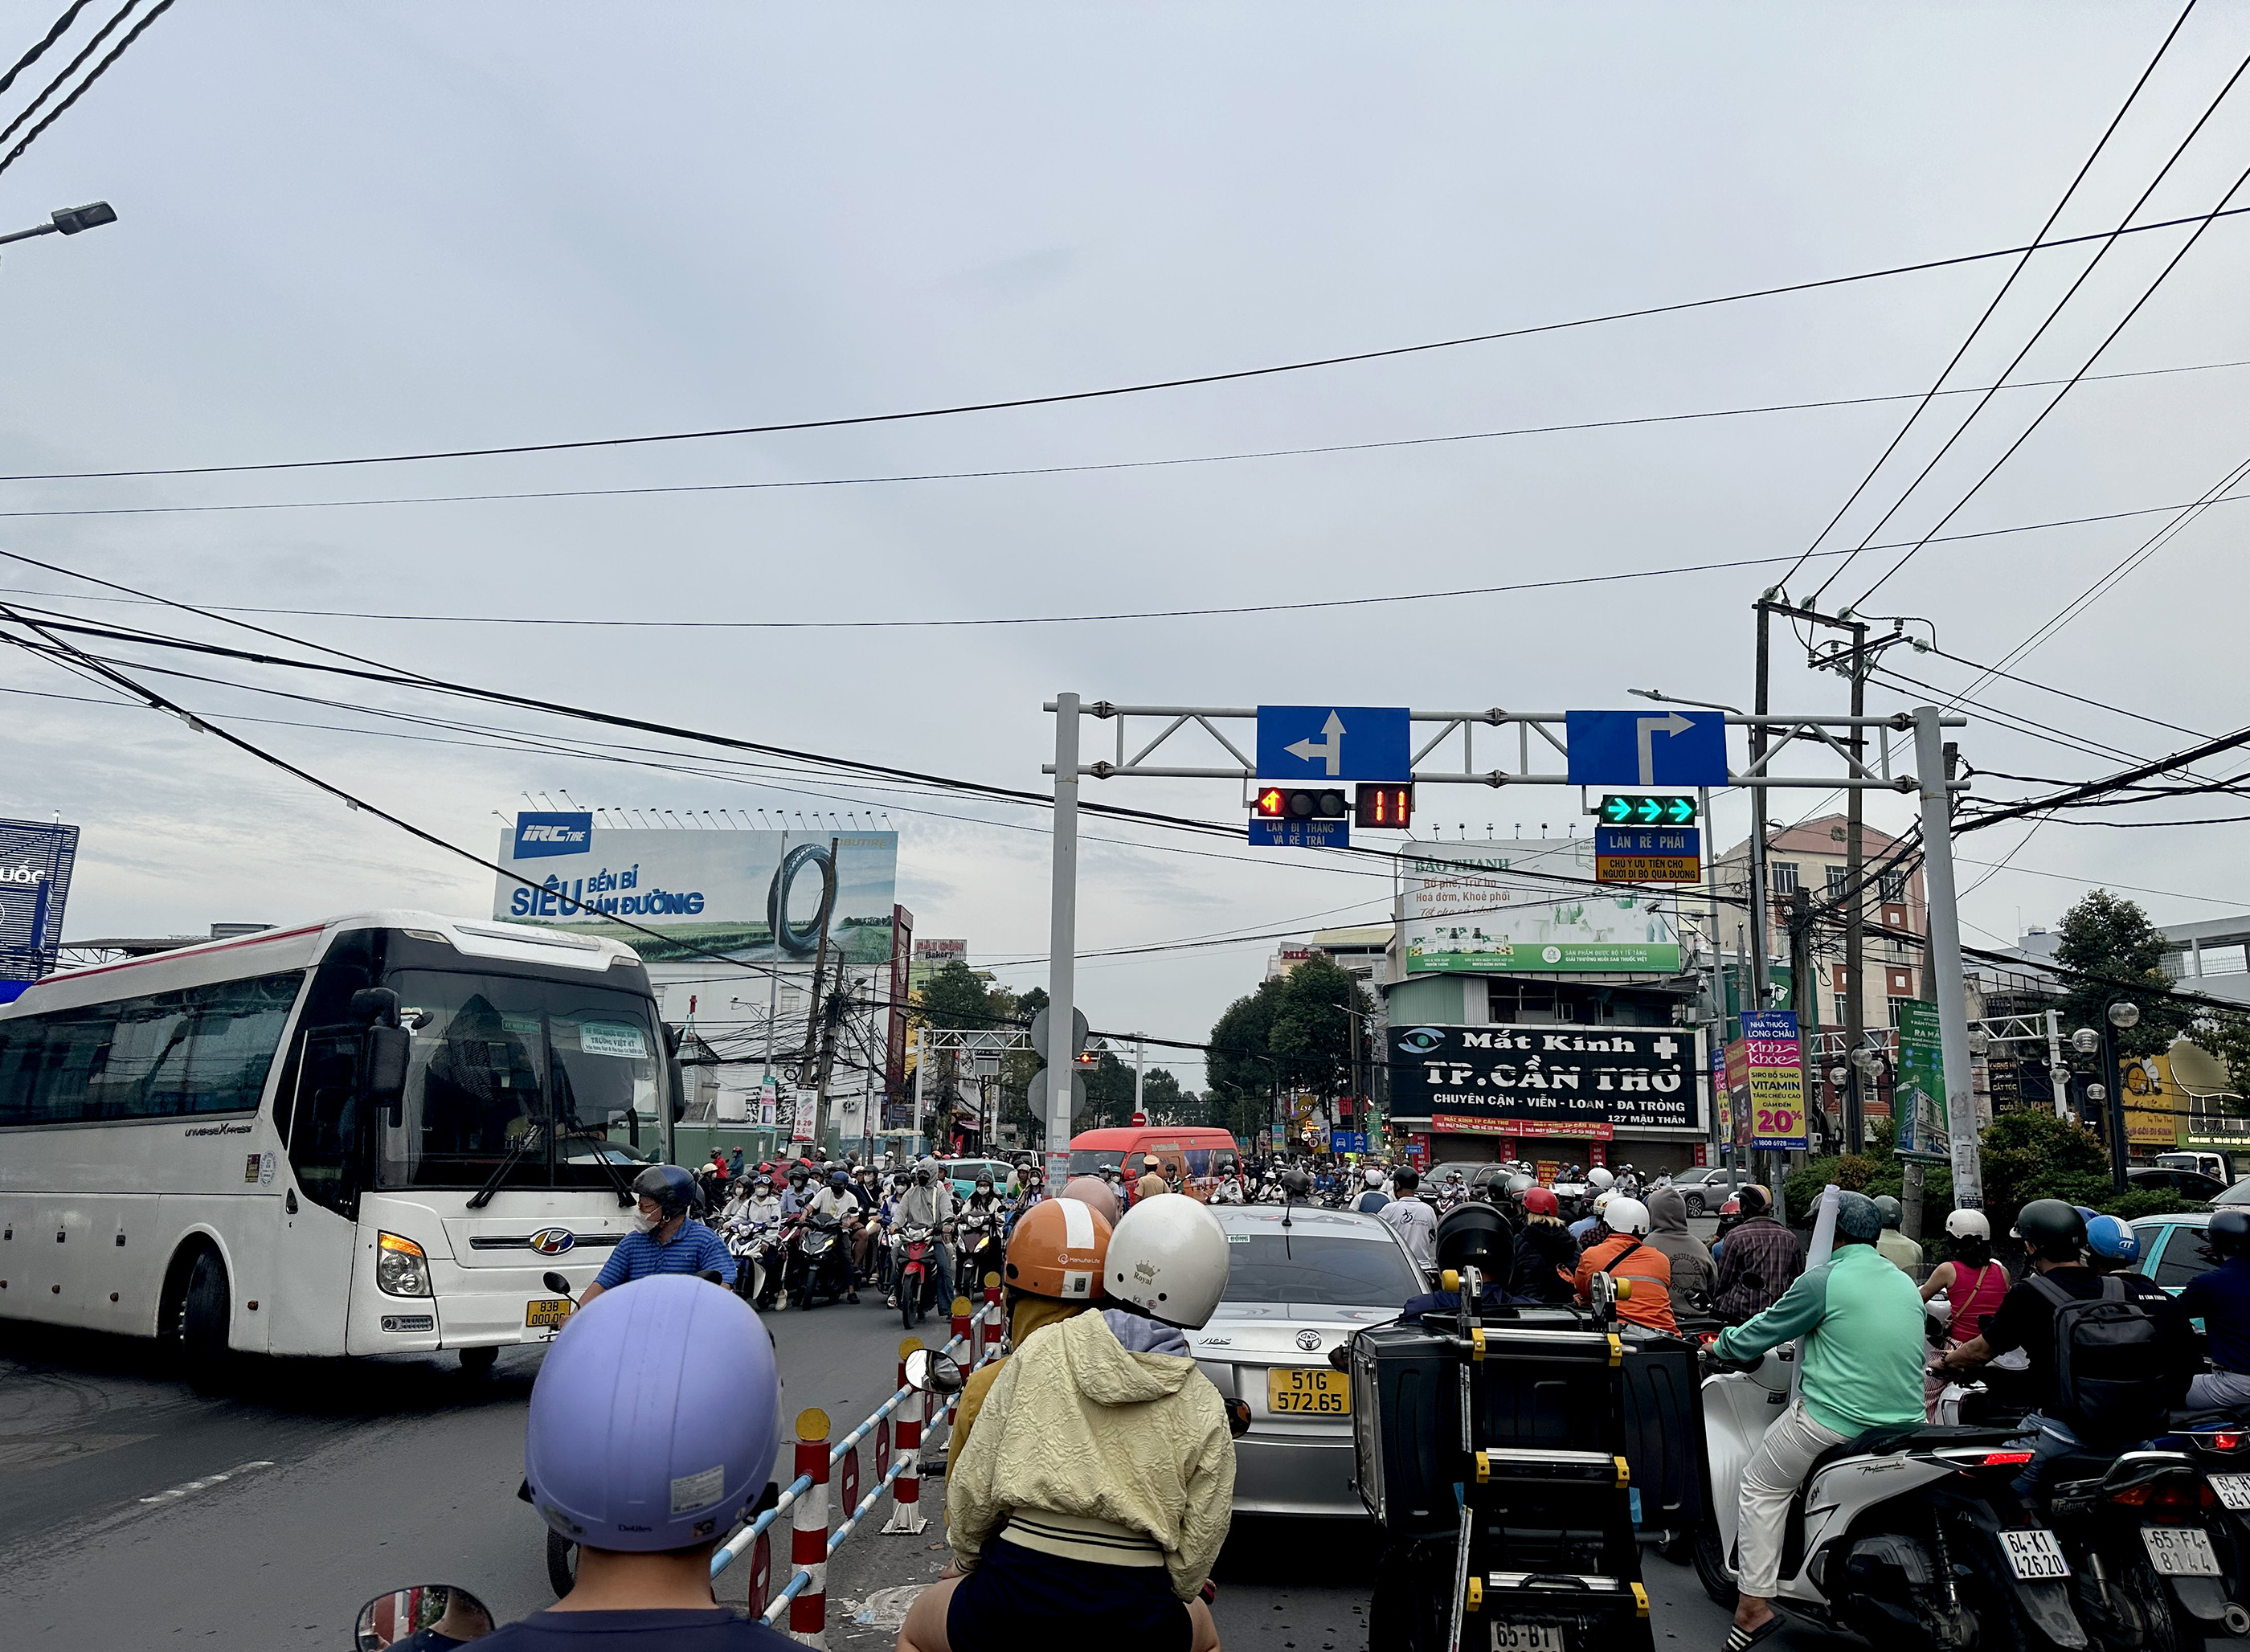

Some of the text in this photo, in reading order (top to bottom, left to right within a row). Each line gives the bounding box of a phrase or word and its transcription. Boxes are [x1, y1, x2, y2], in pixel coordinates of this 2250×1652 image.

[1377, 791, 1405, 821] 11
[1291, 823, 1299, 832] ĐI
[565, 831, 586, 842] TIRE
[828, 837, 888, 848] OBUTIRE
[1273, 833, 1325, 845] VÀ RẼ TRÁI
[1610, 832, 1684, 848] LÀN RẼ PHẢI
[1667, 860, 1683, 868] CHO
[1628, 869, 1636, 878] ĐI
[1651, 869, 1667, 879] QUA
[510, 874, 583, 916] SIÊU
[584, 889, 705, 916] BÁM ĐƯỜNG
[1765, 1020, 1790, 1028] THUỐC
[1748, 1028, 1795, 1038] LONG CHÂU
[1914, 1029, 1925, 1037] RA
[1462, 1029, 1636, 1053] Mắt Kính
[1596, 1064, 1681, 1093] THƠ
[1751, 1081, 1800, 1090] VITAMIN
[1433, 1092, 1685, 1112] CHUYÊN CẬN VIỄN LOAN ĐA TRÒNG
[1607, 1114, 1686, 1125] 127 MẬU THÂN
[1134, 1271, 1153, 1286] Royal
[540, 1301, 559, 1312] 83B
[1197, 1337, 1232, 1345] VIOS
[1291, 1372, 1327, 1390] 51G
[1278, 1392, 1342, 1412] 572.65
[2007, 1531, 2052, 1553] 64-K1
[2152, 1531, 2203, 1549] 65-F4
[2014, 1554, 2065, 1576] 426.20
[2160, 1552, 2210, 1571] 8144
